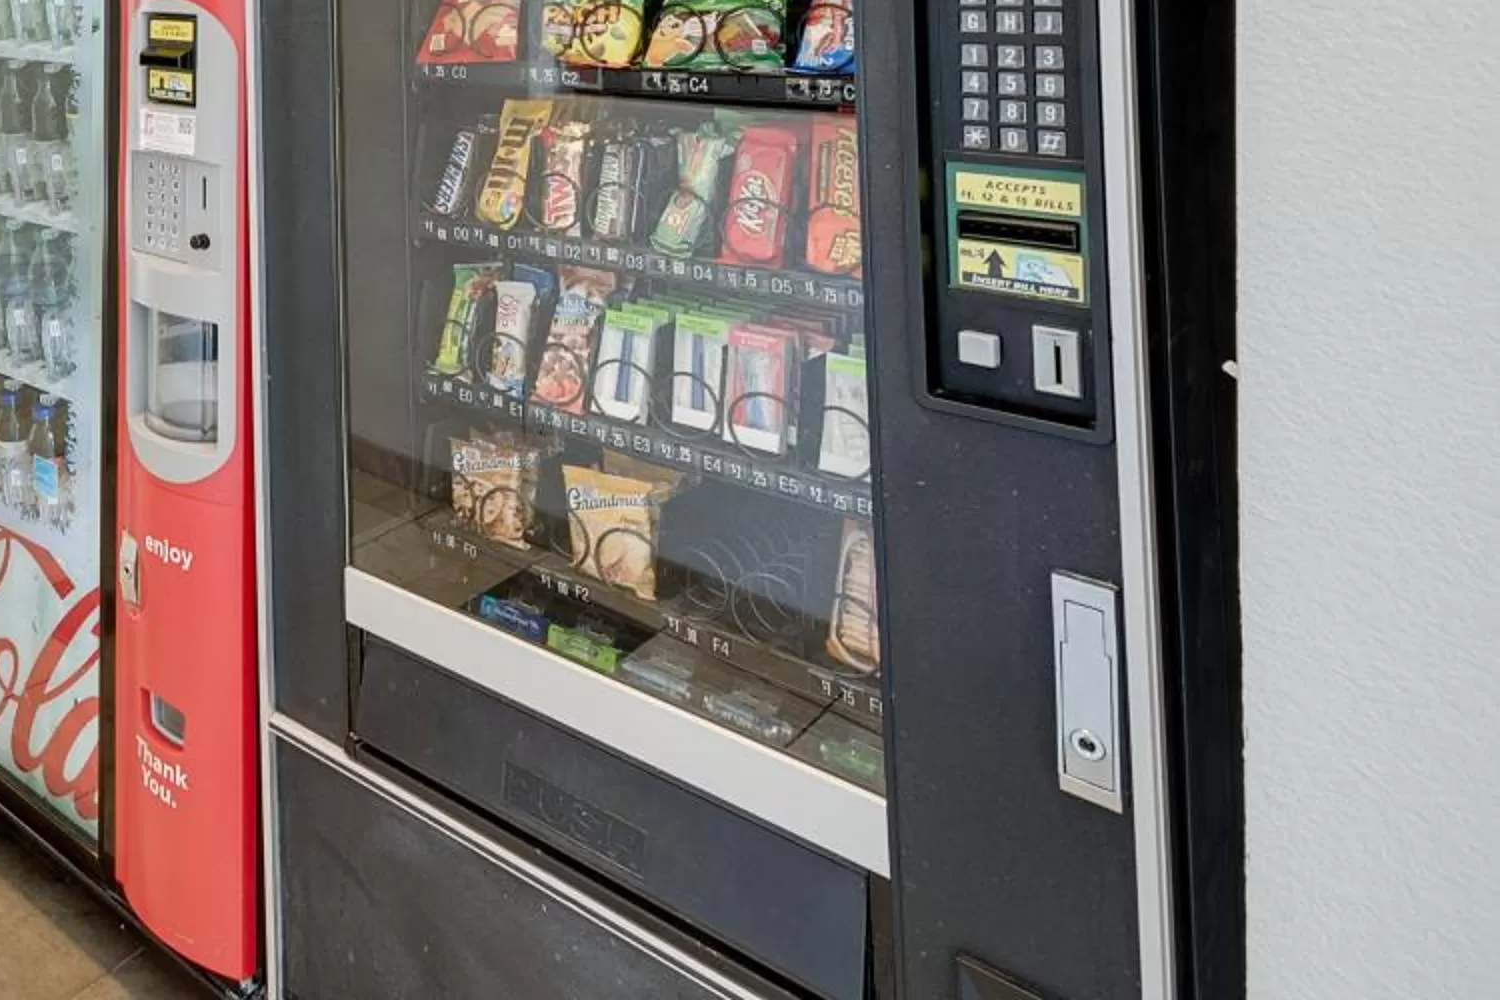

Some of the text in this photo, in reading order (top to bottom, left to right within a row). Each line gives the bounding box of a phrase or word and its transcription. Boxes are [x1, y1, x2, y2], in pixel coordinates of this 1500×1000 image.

[967, 14, 979, 29] G
[1004, 15, 1016, 28] H
[1004, 49, 1016, 65] 2
[1043, 50, 1054, 65] 3
[561, 71, 580, 85] C2
[688, 77, 709, 93] C4
[969, 76, 1055, 93] 4 5 6
[970, 101, 1056, 121] 7 8 9
[1007, 131, 1018, 147] 0
[985, 180, 1046, 195] ACCEPTS
[1035, 199, 1074, 211] BILLS
[693, 266, 713, 281] D4
[771, 277, 793, 295] D5
[848, 290, 864, 306] D
[509, 402, 524, 418] E1
[571, 419, 588, 435] E2
[633, 435, 650, 452] E3
[703, 455, 722, 473] E4
[779, 475, 799, 494] E5
[145, 534, 193, 571] enjoy
[575, 585, 590, 601] F2
[712, 637, 730, 657] F4
[136, 735, 188, 790] Thank
[141, 766, 177, 809] You.
